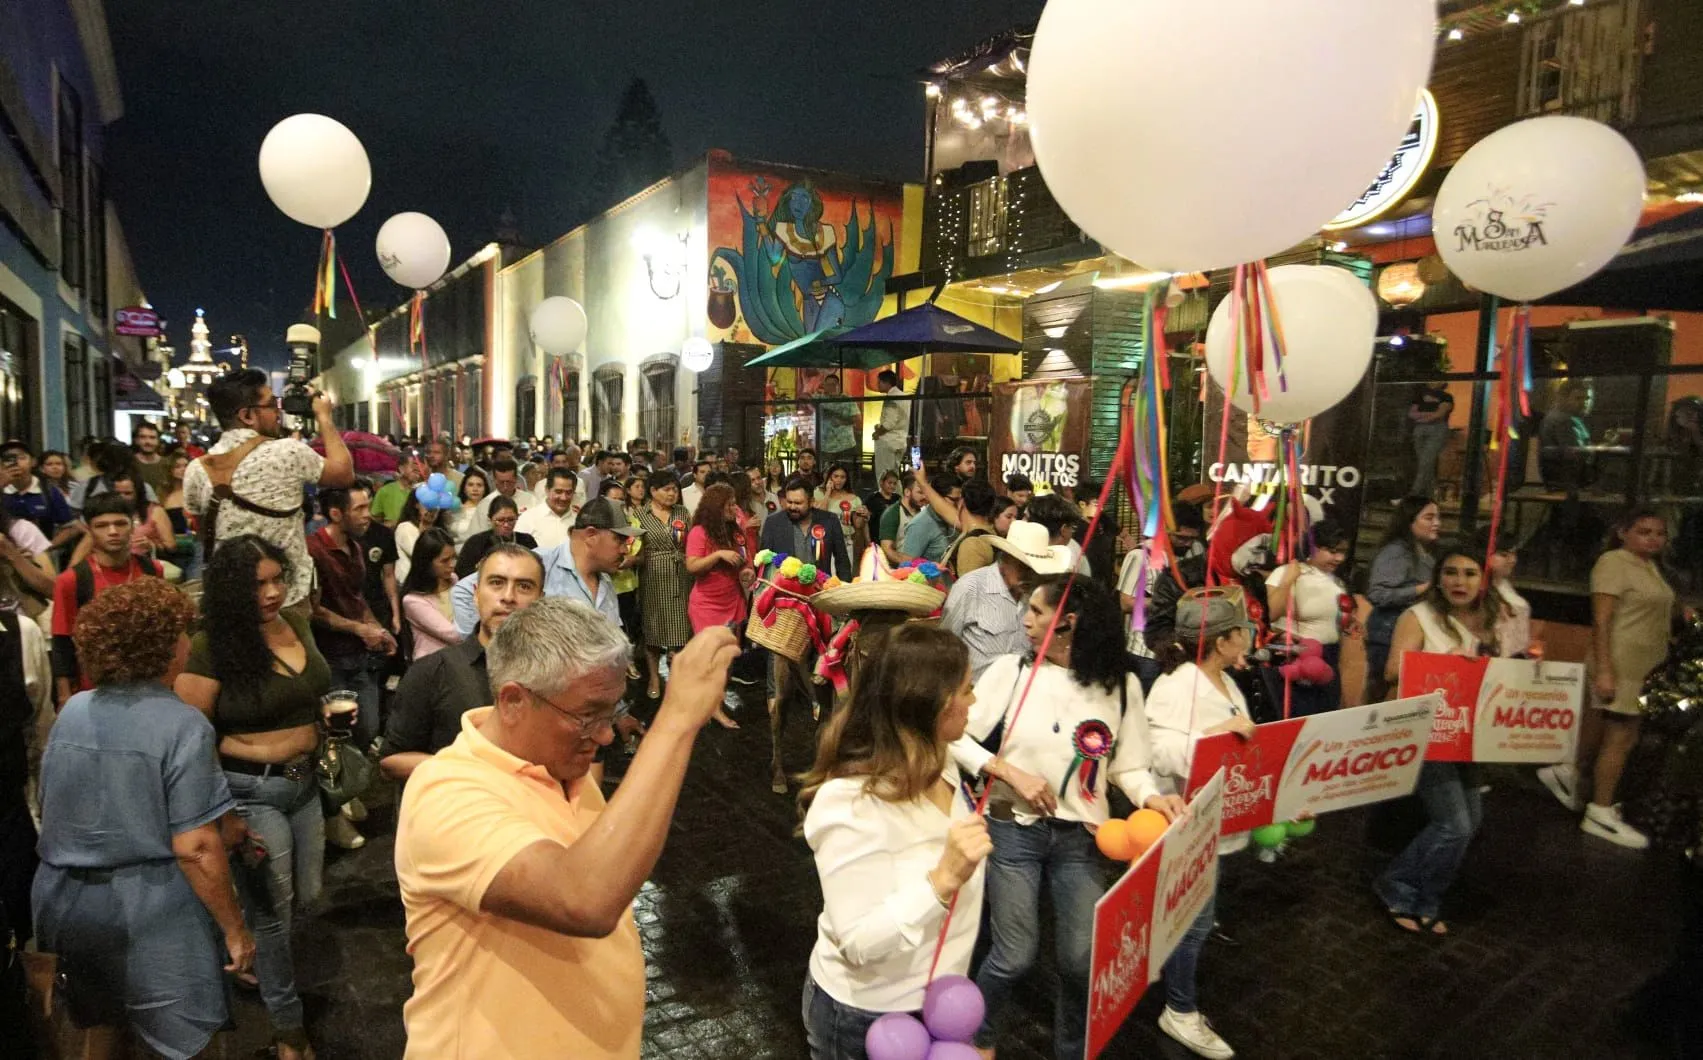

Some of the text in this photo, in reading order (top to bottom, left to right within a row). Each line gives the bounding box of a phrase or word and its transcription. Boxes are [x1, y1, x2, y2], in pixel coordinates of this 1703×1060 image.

[1001, 453, 1080, 473] MOJITOS
[1492, 702, 1575, 730] MÁGICO
[1301, 743, 1419, 786] MÁGICO
